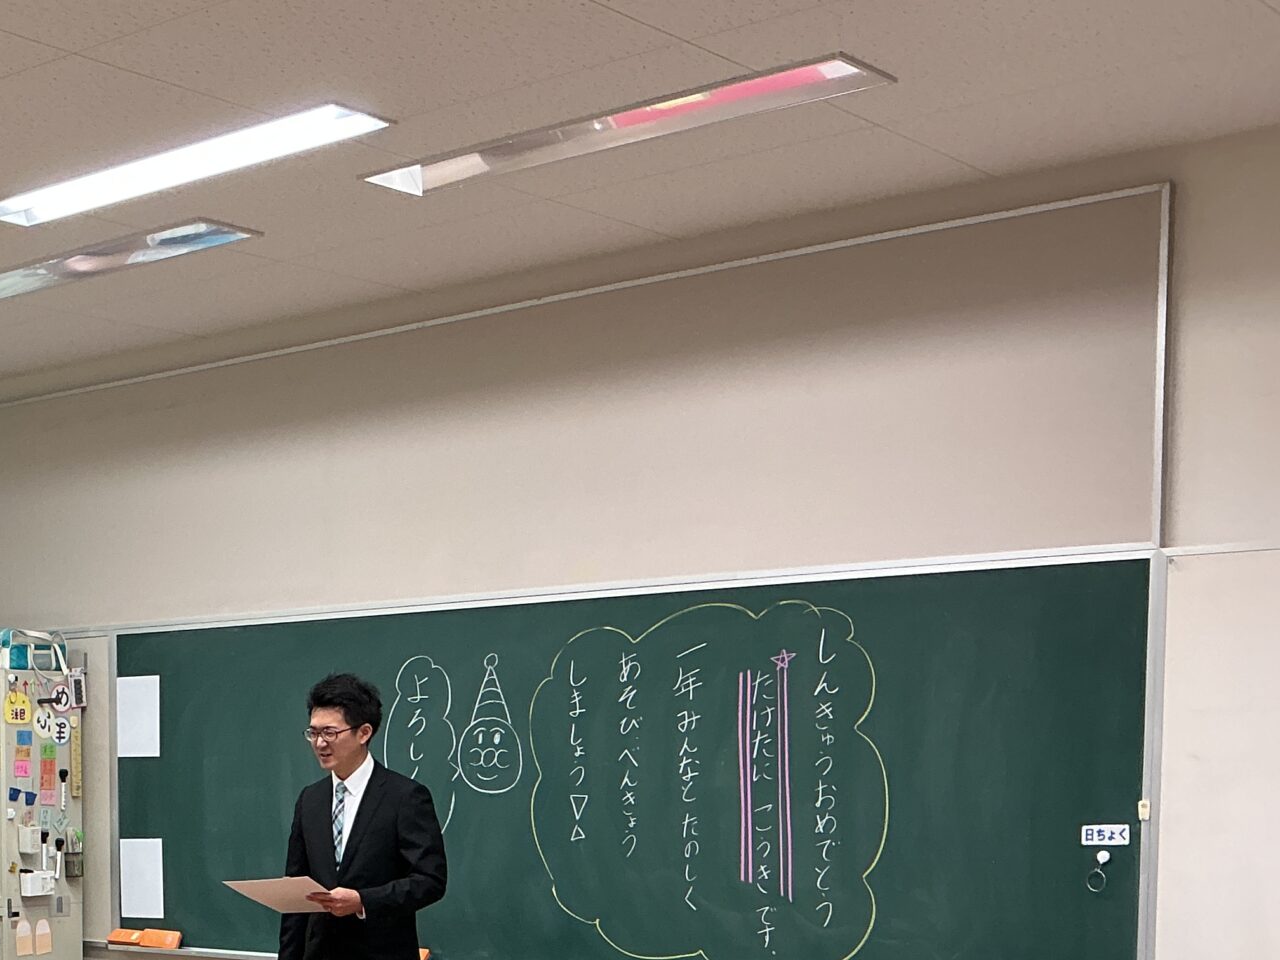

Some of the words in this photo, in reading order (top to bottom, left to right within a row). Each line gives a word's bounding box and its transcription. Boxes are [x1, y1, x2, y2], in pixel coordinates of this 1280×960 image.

[812, 627, 841, 928] しんきゅうおめでとう
[1085, 828, 1127, 842] 日ちょく
